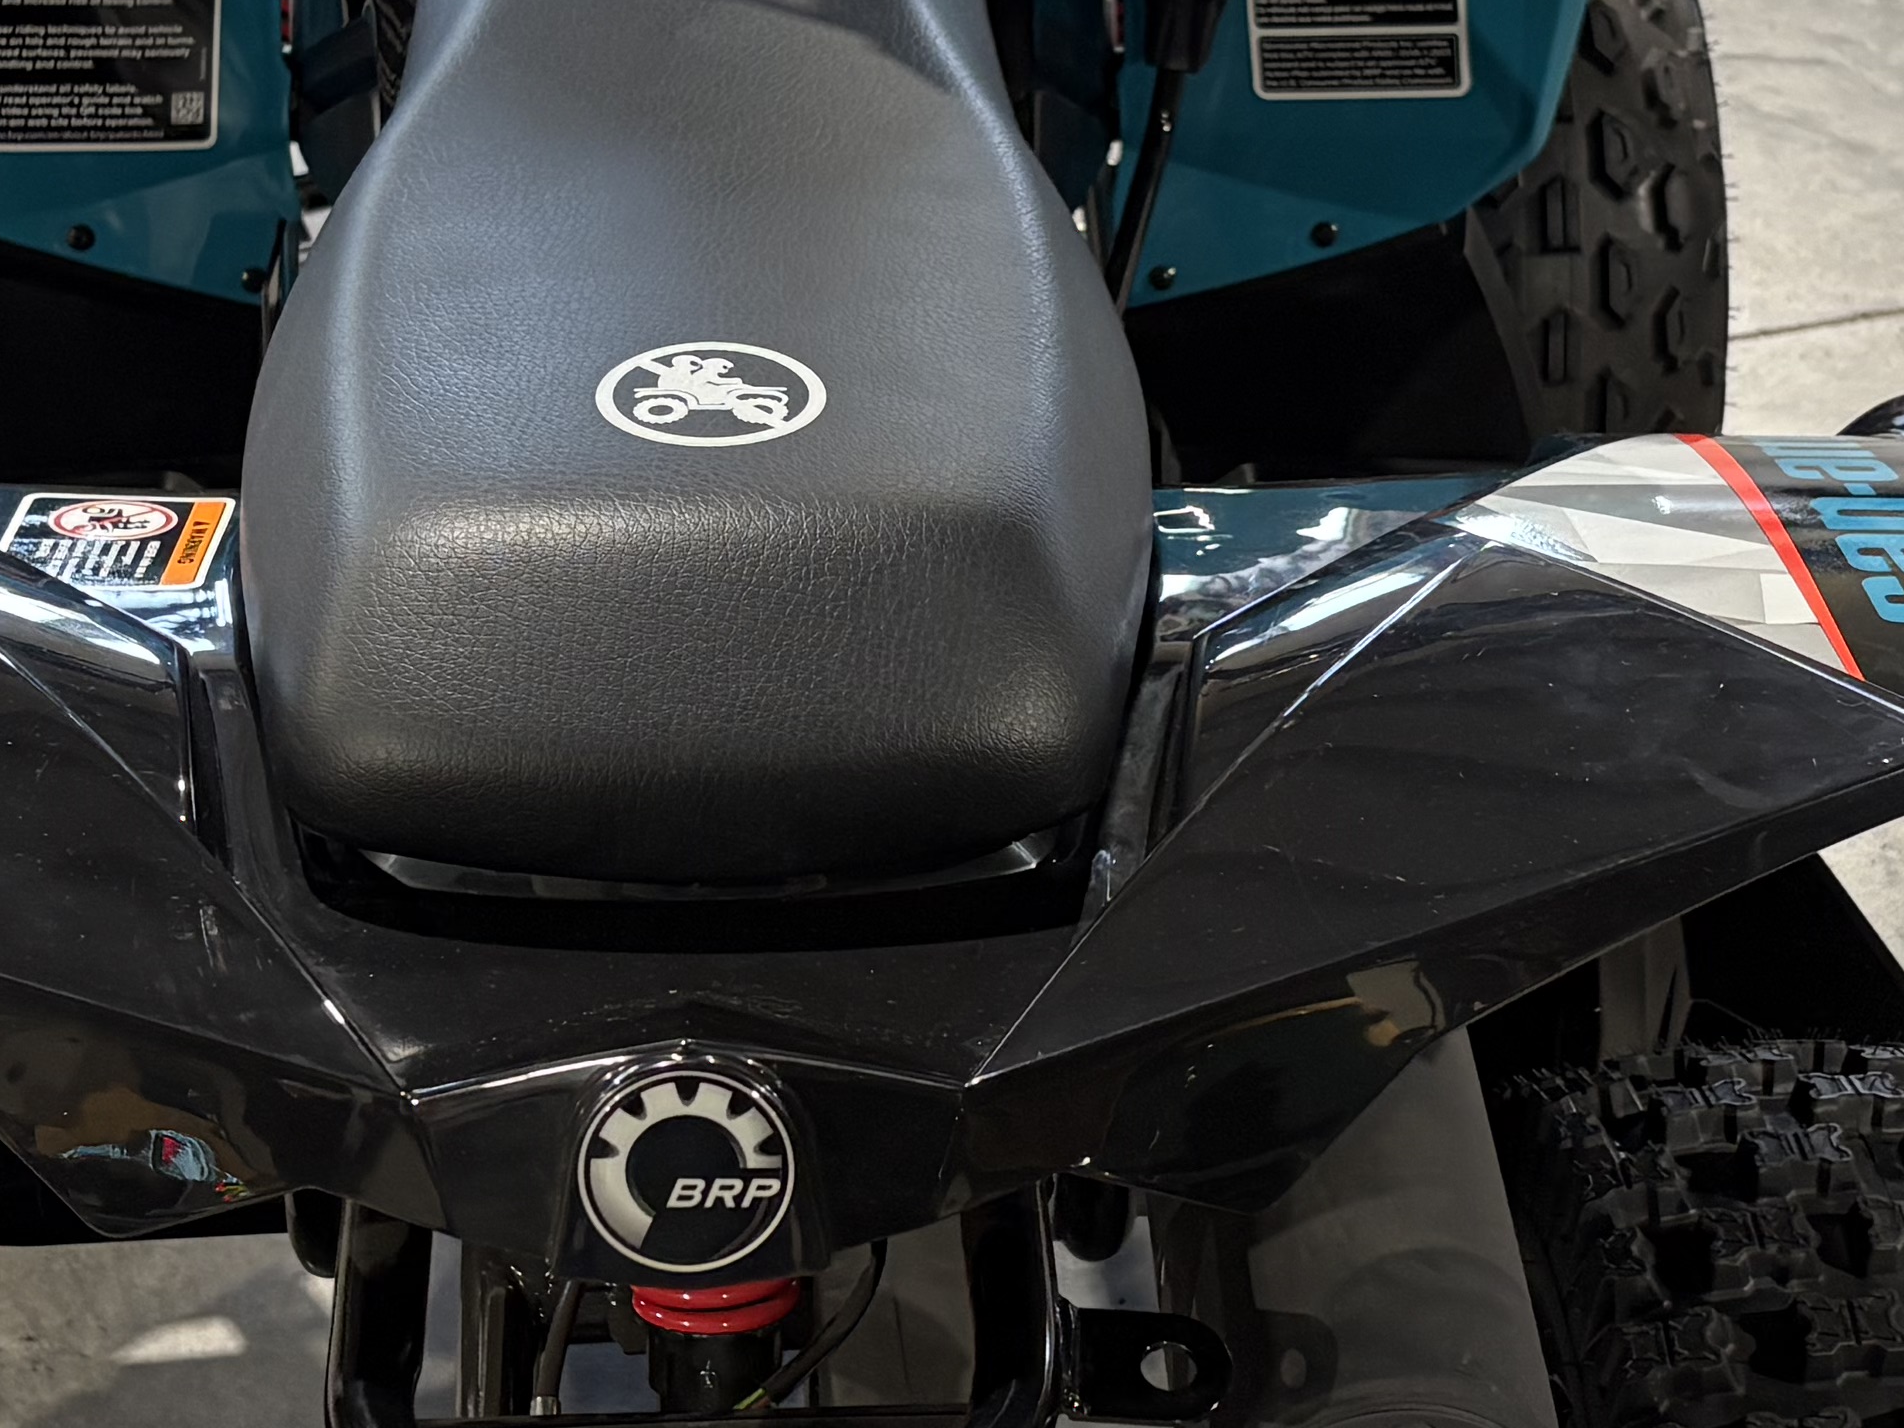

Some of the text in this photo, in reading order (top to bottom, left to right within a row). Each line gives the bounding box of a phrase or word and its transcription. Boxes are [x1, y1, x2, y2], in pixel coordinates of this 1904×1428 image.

[15, 25, 45, 36] riding
[47, 24, 102, 36] techniques
[117, 25, 146, 35] avoid
[148, 25, 183, 35] vehicle
[46, 37, 66, 47] and
[67, 36, 97, 48] rough
[135, 36, 153, 47] and
[121, 48, 142, 60] may
[144, 47, 190, 59] seriously
[35, 59, 55, 70] and
[0, 83, 57, 94] understand
[73, 83, 104, 96] safety
[3, 95, 27, 105] read
[28, 94, 79, 107] operator's
[81, 95, 110, 108] guide
[111, 95, 131, 105] and
[133, 94, 164, 105] watch
[0, 106, 29, 117] video
[31, 106, 59, 118] using
[61, 106, 78, 117] the
[98, 106, 122, 116] code
[27, 117, 49, 128] web
[50, 117, 69, 128] site
[70, 117, 103, 128] before
[177, 528, 208, 564] WARNING
[666, 1178, 782, 1208] BRP
